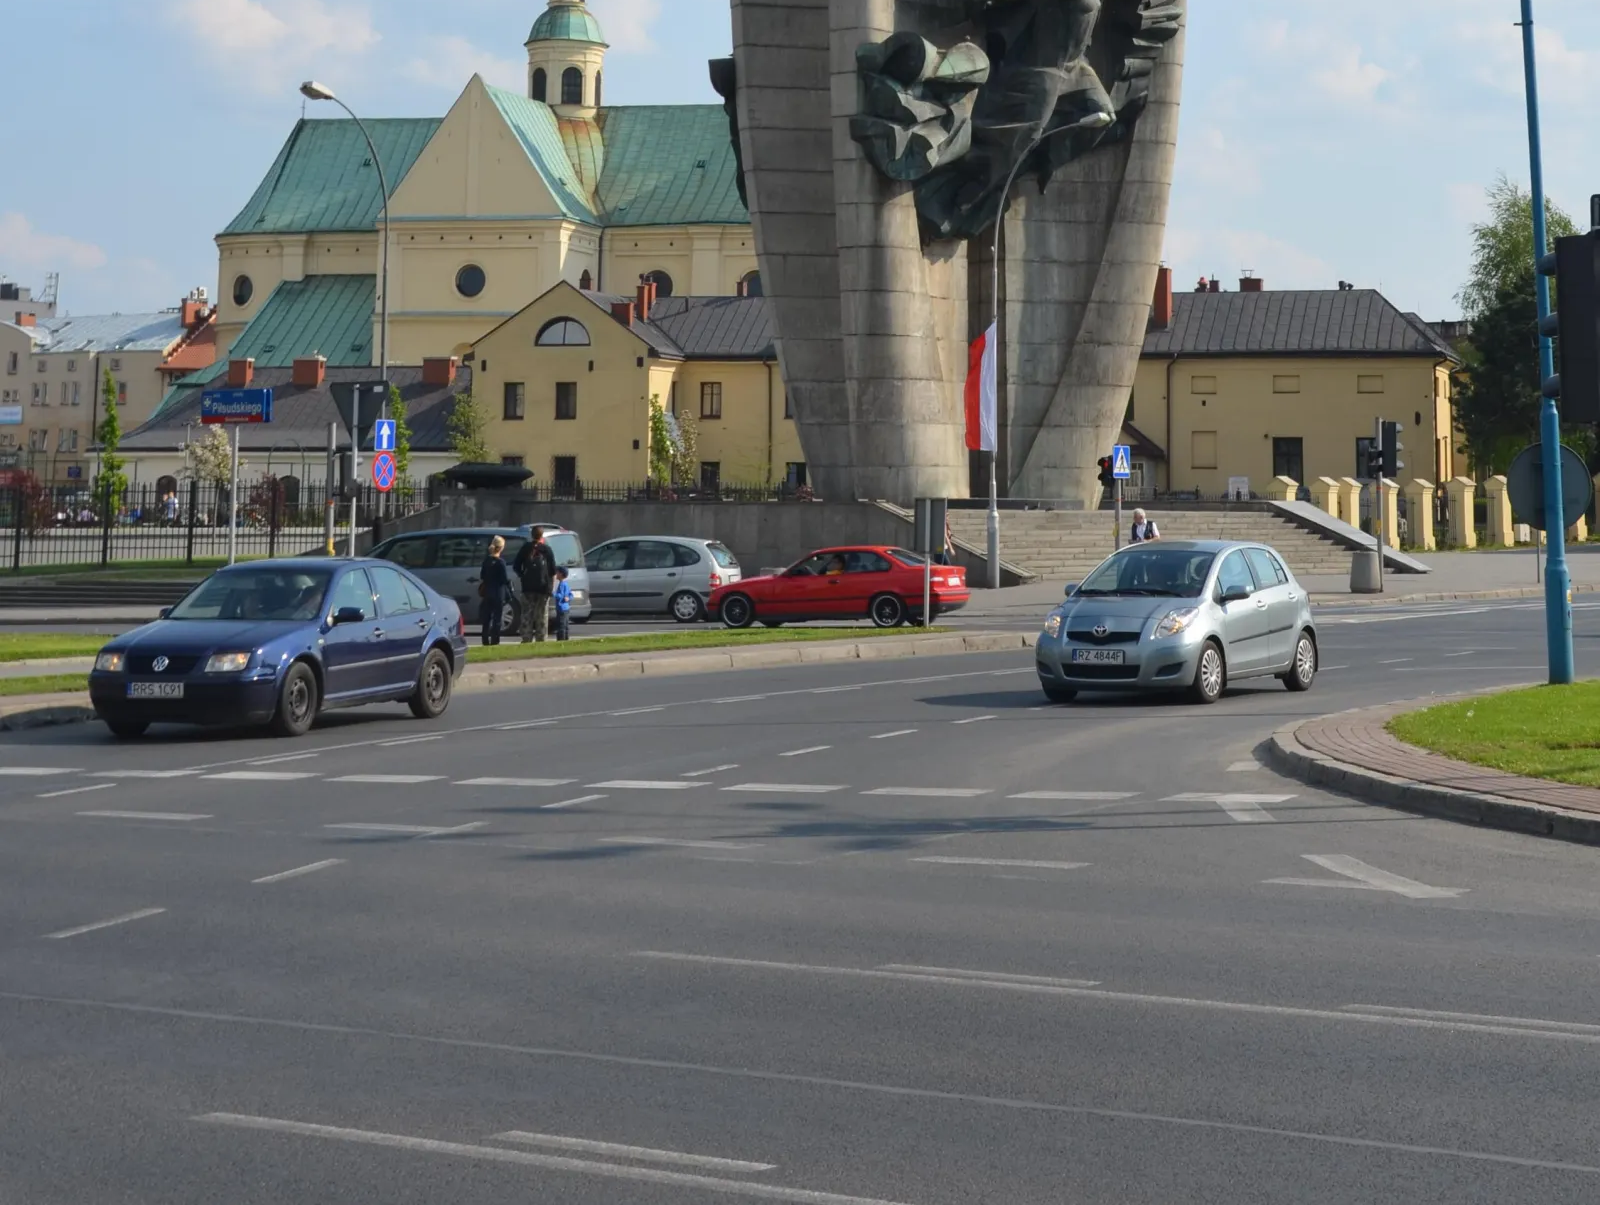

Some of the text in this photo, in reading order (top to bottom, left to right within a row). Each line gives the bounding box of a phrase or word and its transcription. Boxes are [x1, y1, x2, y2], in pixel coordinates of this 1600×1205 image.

[1078, 650, 1122, 662] RZ 4844F
[133, 683, 154, 695] RRS
